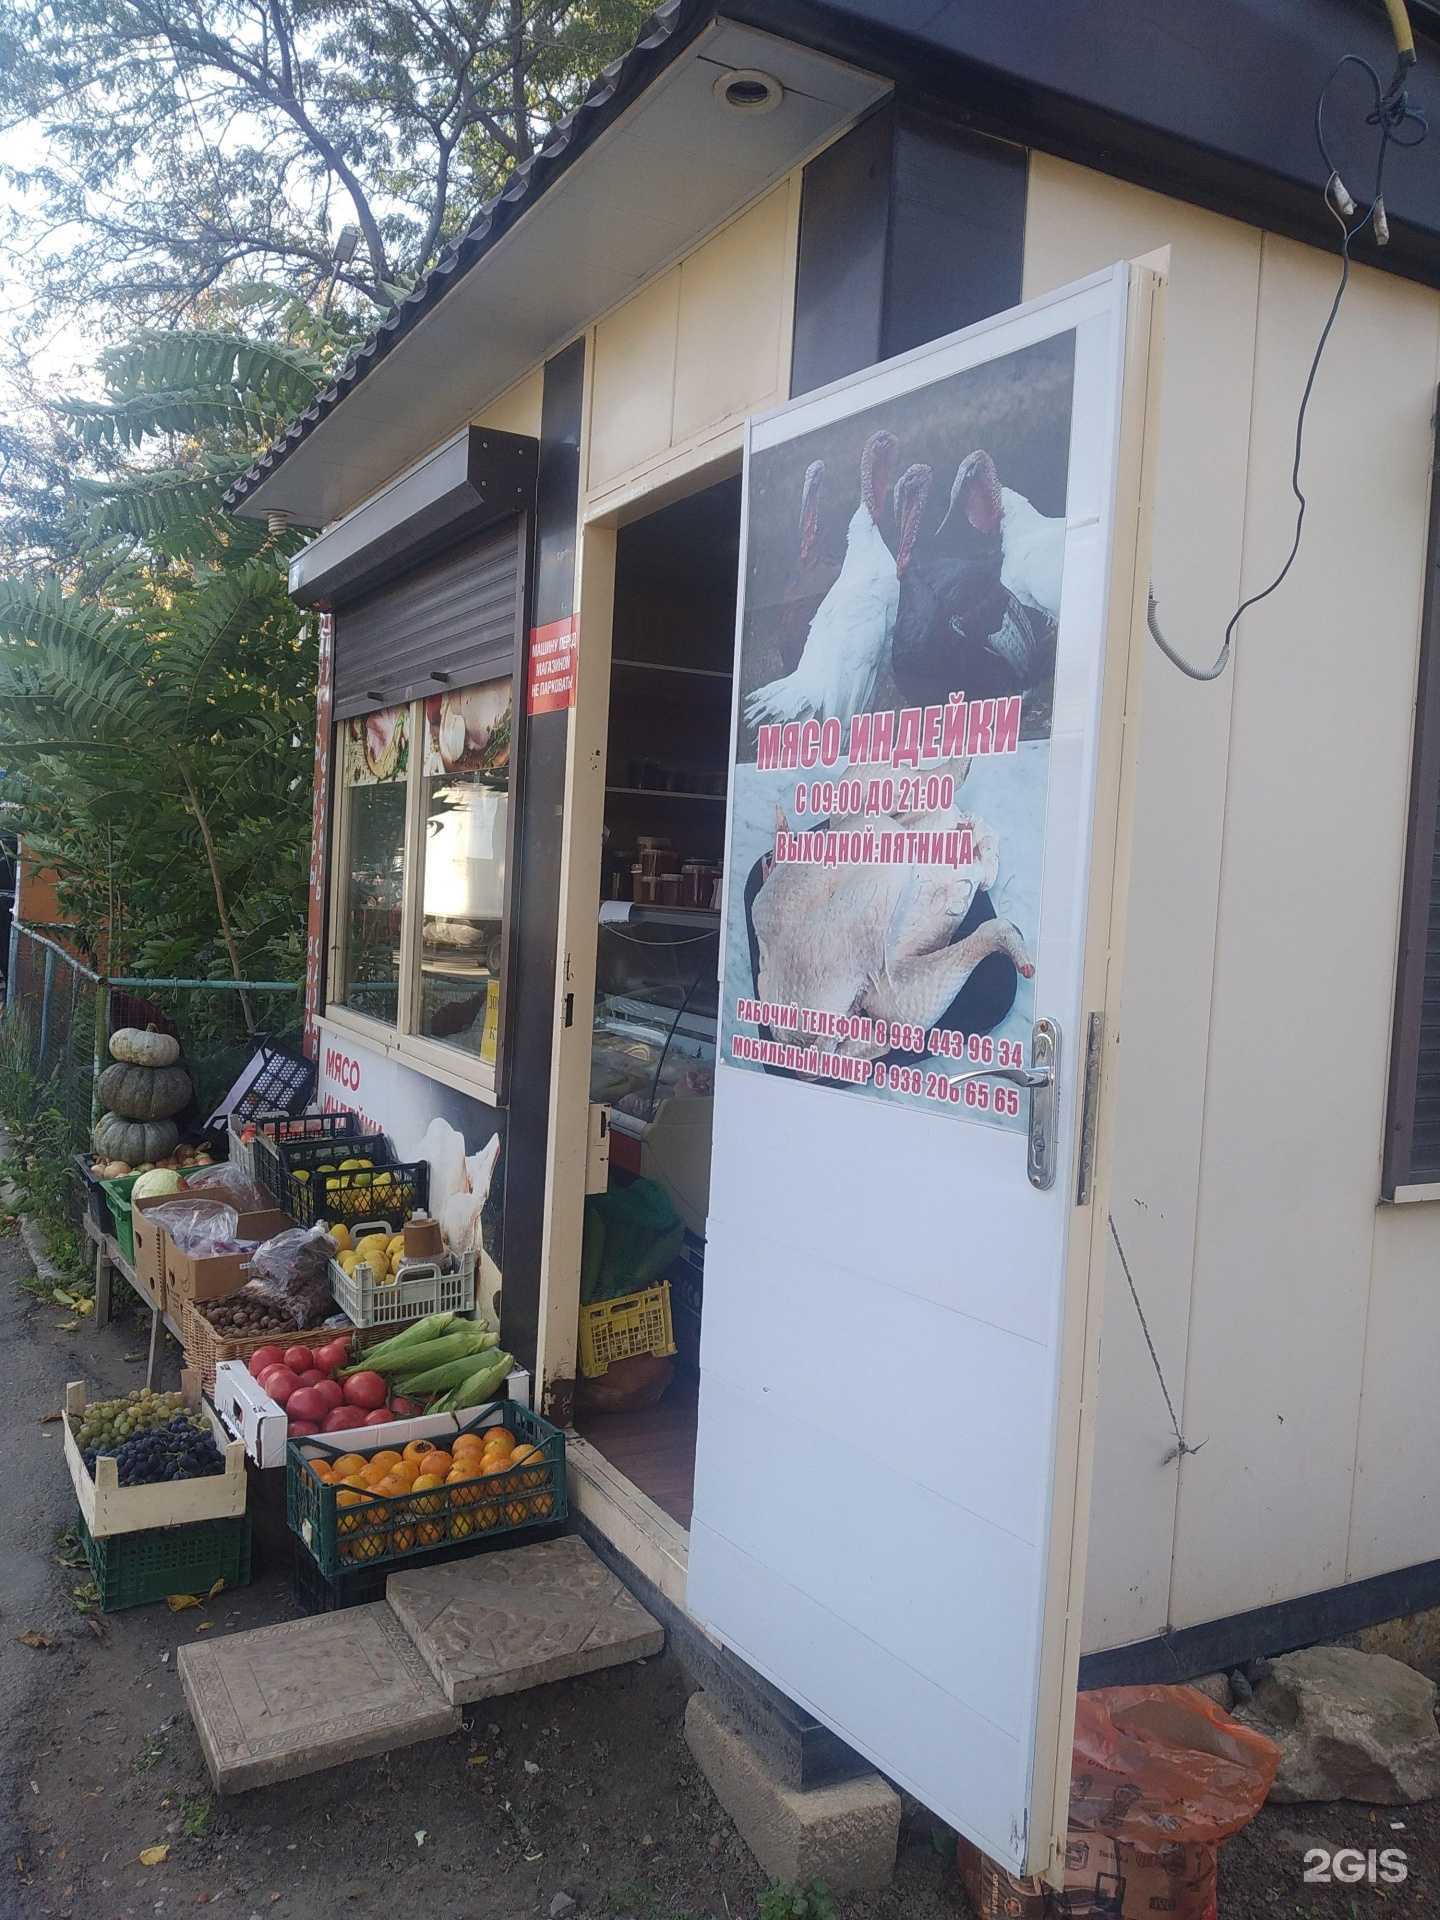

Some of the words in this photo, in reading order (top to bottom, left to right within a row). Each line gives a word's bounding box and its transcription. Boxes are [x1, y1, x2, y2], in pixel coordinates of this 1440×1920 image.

[531, 638, 558, 657] МАШИНУ
[536, 655, 571, 677] МАГАЗИНОМ
[531, 681, 540, 697] НЕ
[757, 718, 841, 771] МЯСО
[848, 691, 1022, 769] ИНДЕЙКИ
[794, 783, 808, 815] С
[811, 780, 862, 814] 09:00
[865, 778, 893, 817] ДО
[898, 774, 954, 812] 21:00
[737, 998, 798, 1030] РАБОЧИЙ
[801, 1009, 872, 1042] ТЕЛЕФОН
[875, 1020, 886, 1046] 8
[890, 1022, 925, 1052] 983
[928, 1028, 963, 1057] 443
[968, 1034, 993, 1064] 96
[999, 1039, 1023, 1068] 34
[325, 1047, 360, 1091] МЯСО
[732, 1035, 819, 1075] МОБИЛЬНЫЙ
[820, 1052, 872, 1084] НОМЕР
[874, 1062, 886, 1088] 8
[889, 1065, 922, 1095] 938
[965, 1081, 990, 1110] 65
[993, 1086, 1019, 1116] 65
